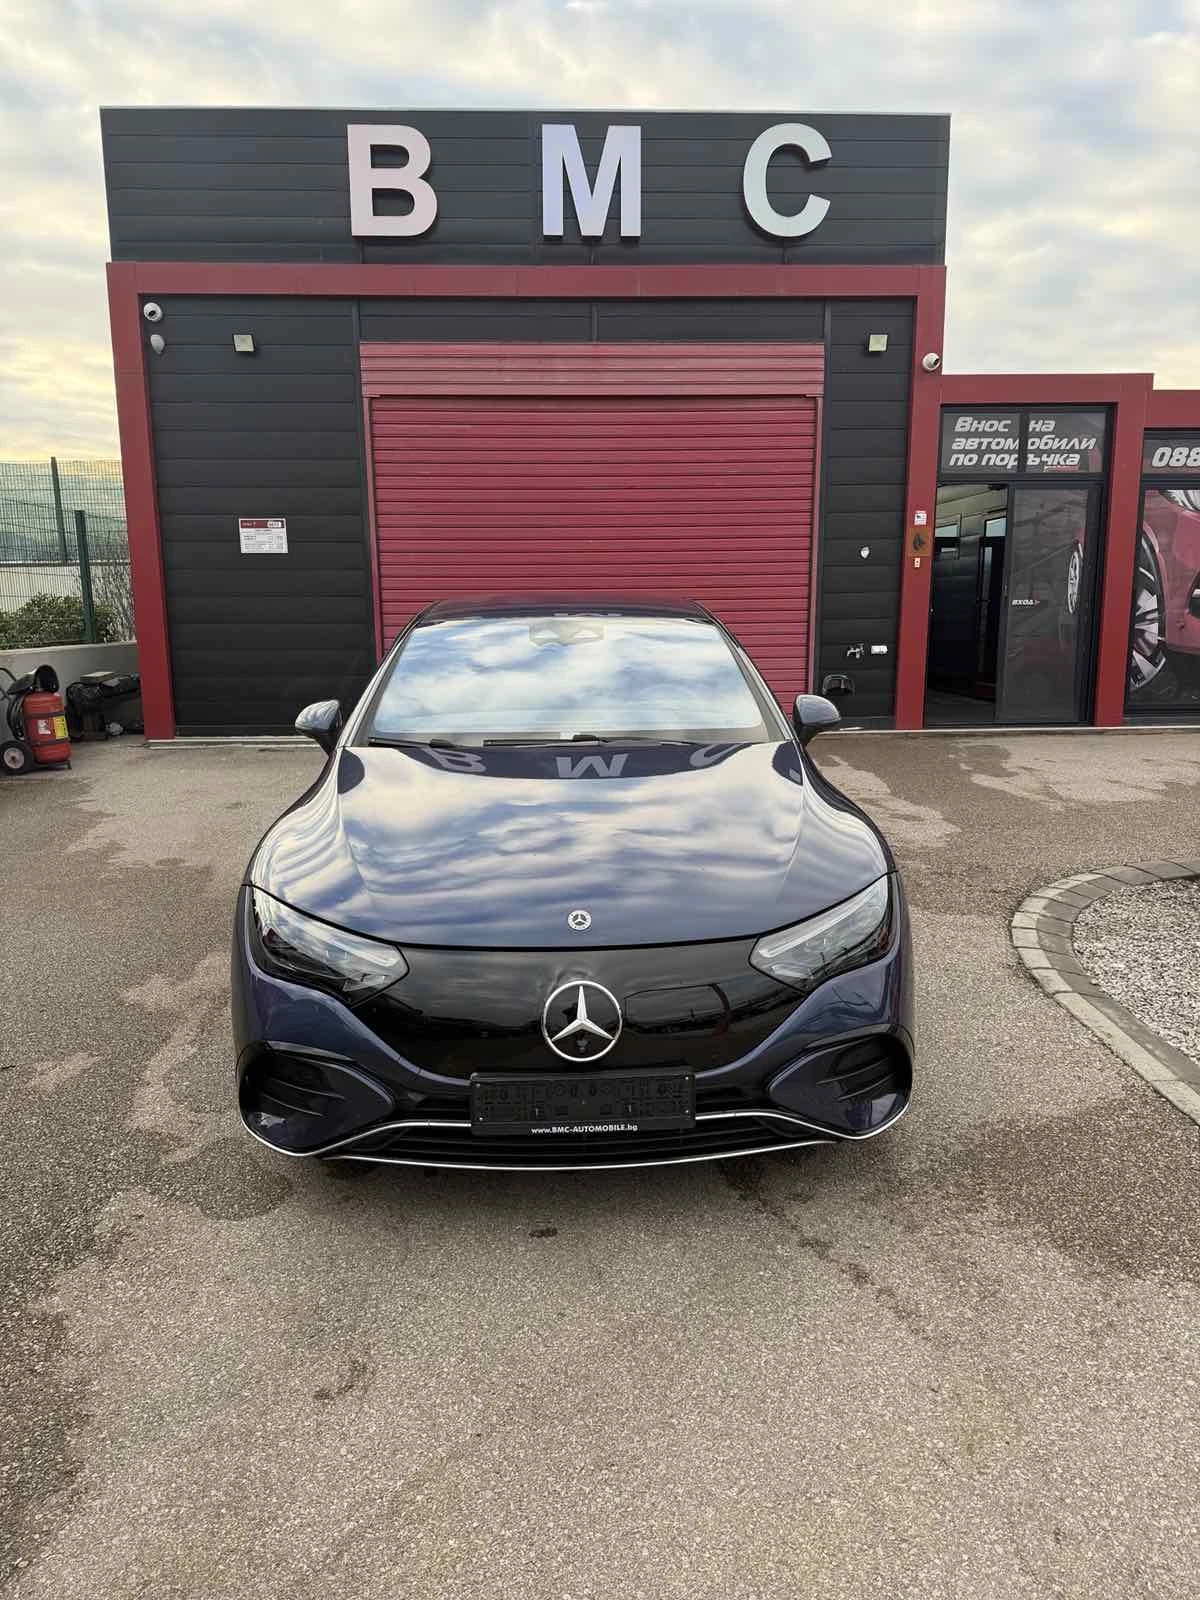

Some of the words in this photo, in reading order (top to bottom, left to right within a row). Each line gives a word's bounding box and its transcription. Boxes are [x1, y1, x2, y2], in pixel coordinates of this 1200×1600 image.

[954, 416, 1012, 432] Внос
[1028, 419, 1056, 432] на
[951, 434, 1097, 450] автомобили
[949, 453, 978, 466] по
[1151, 446, 1200, 467] 088
[531, 1123, 639, 1134] www.BMC-AUTOMOBILE.bg
